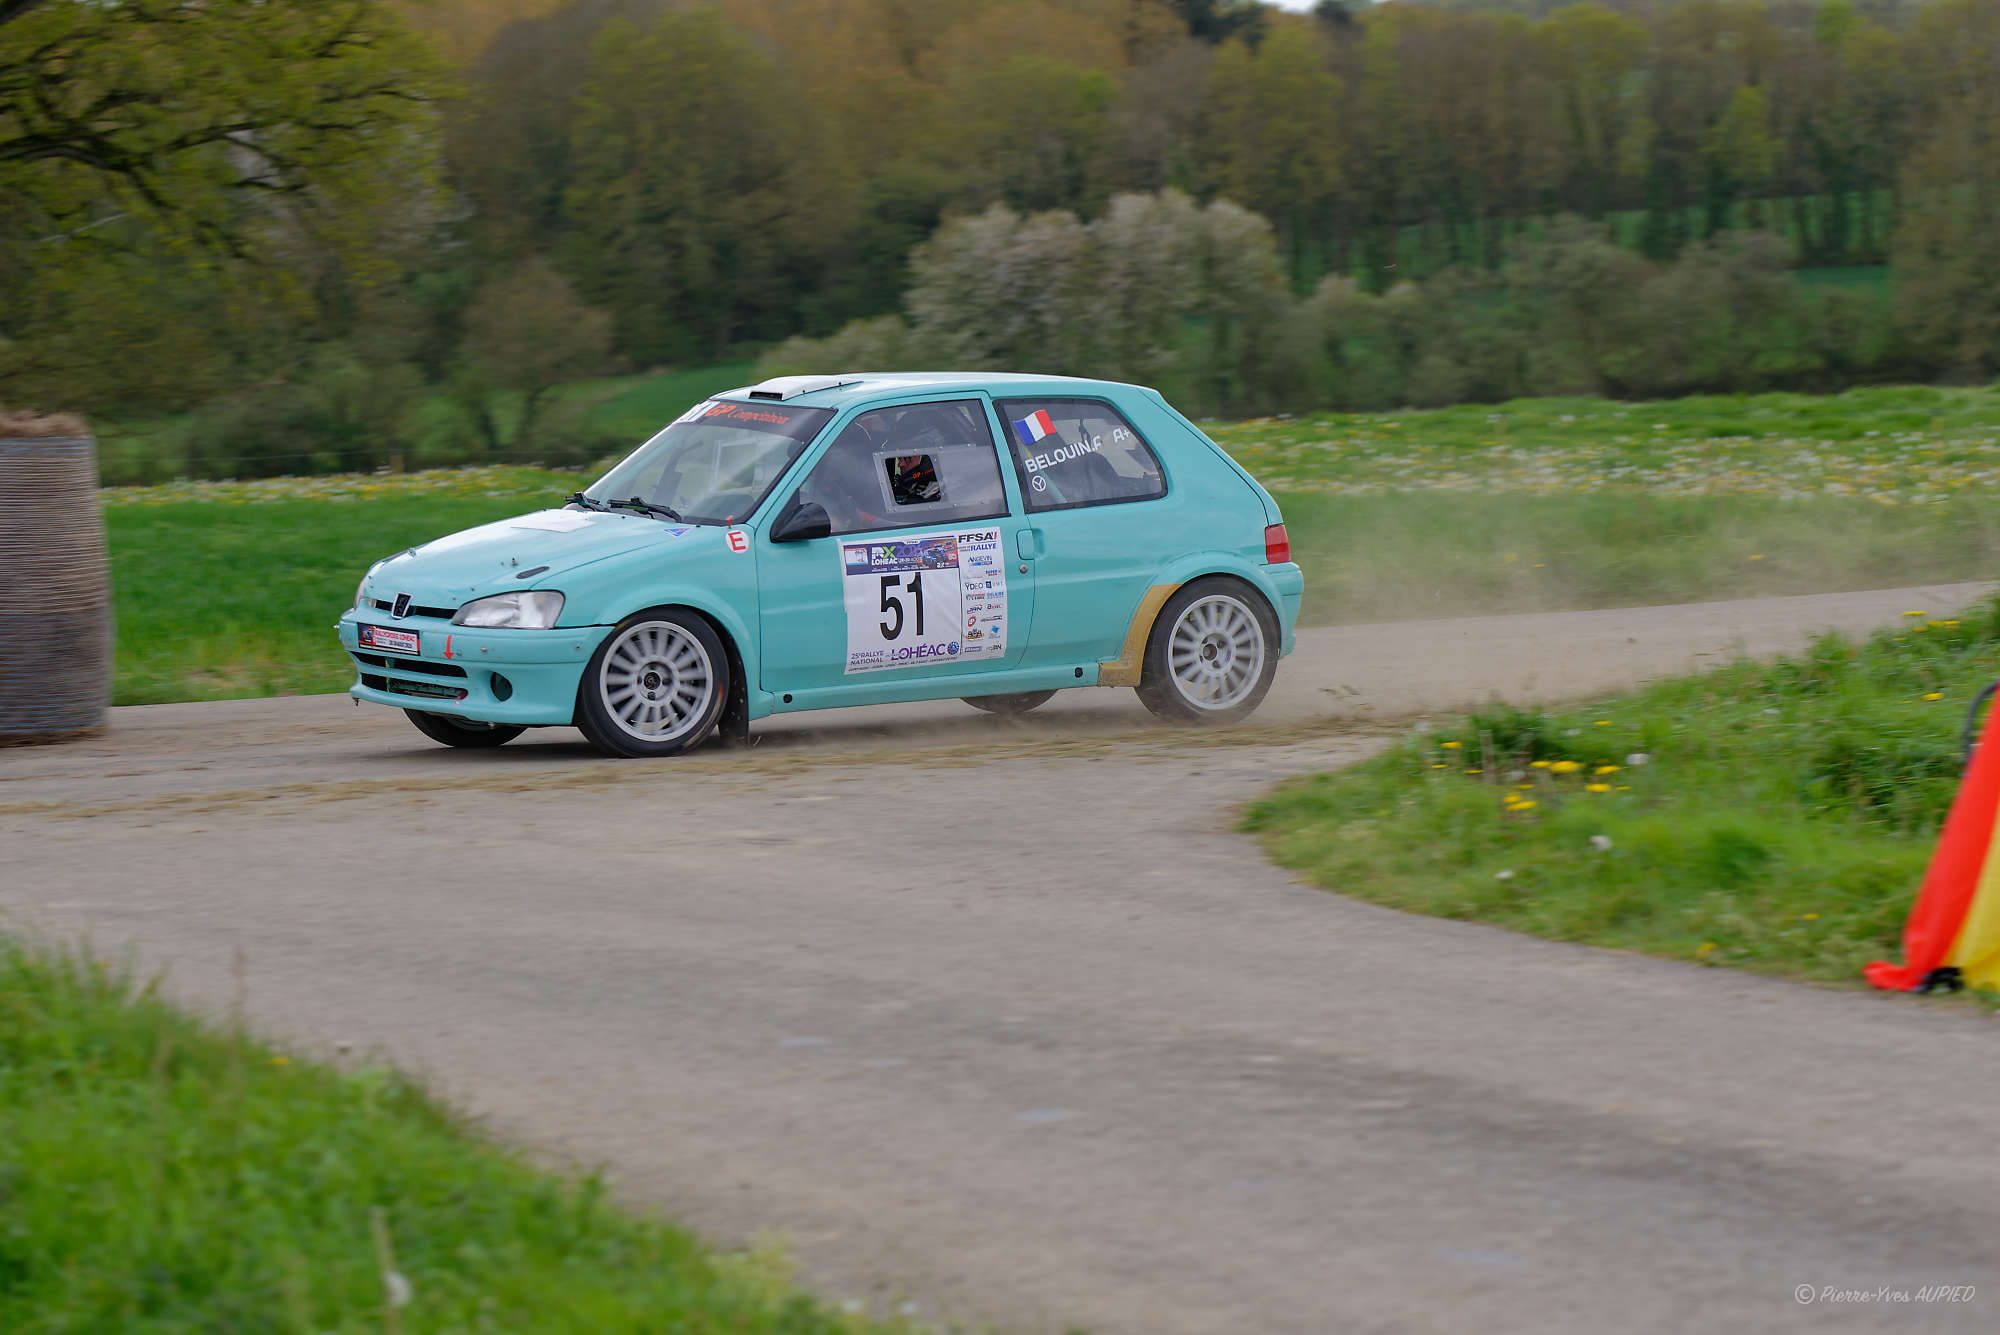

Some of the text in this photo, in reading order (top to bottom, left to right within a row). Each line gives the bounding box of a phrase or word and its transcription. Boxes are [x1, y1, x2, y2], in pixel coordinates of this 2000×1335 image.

[728, 531, 747, 552] E
[958, 532, 994, 544] FFSA
[970, 543, 997, 552] RALLYE
[880, 571, 924, 641] 51
[890, 642, 946, 661] LOHÉAC
[850, 657, 884, 667] NATIONAL
